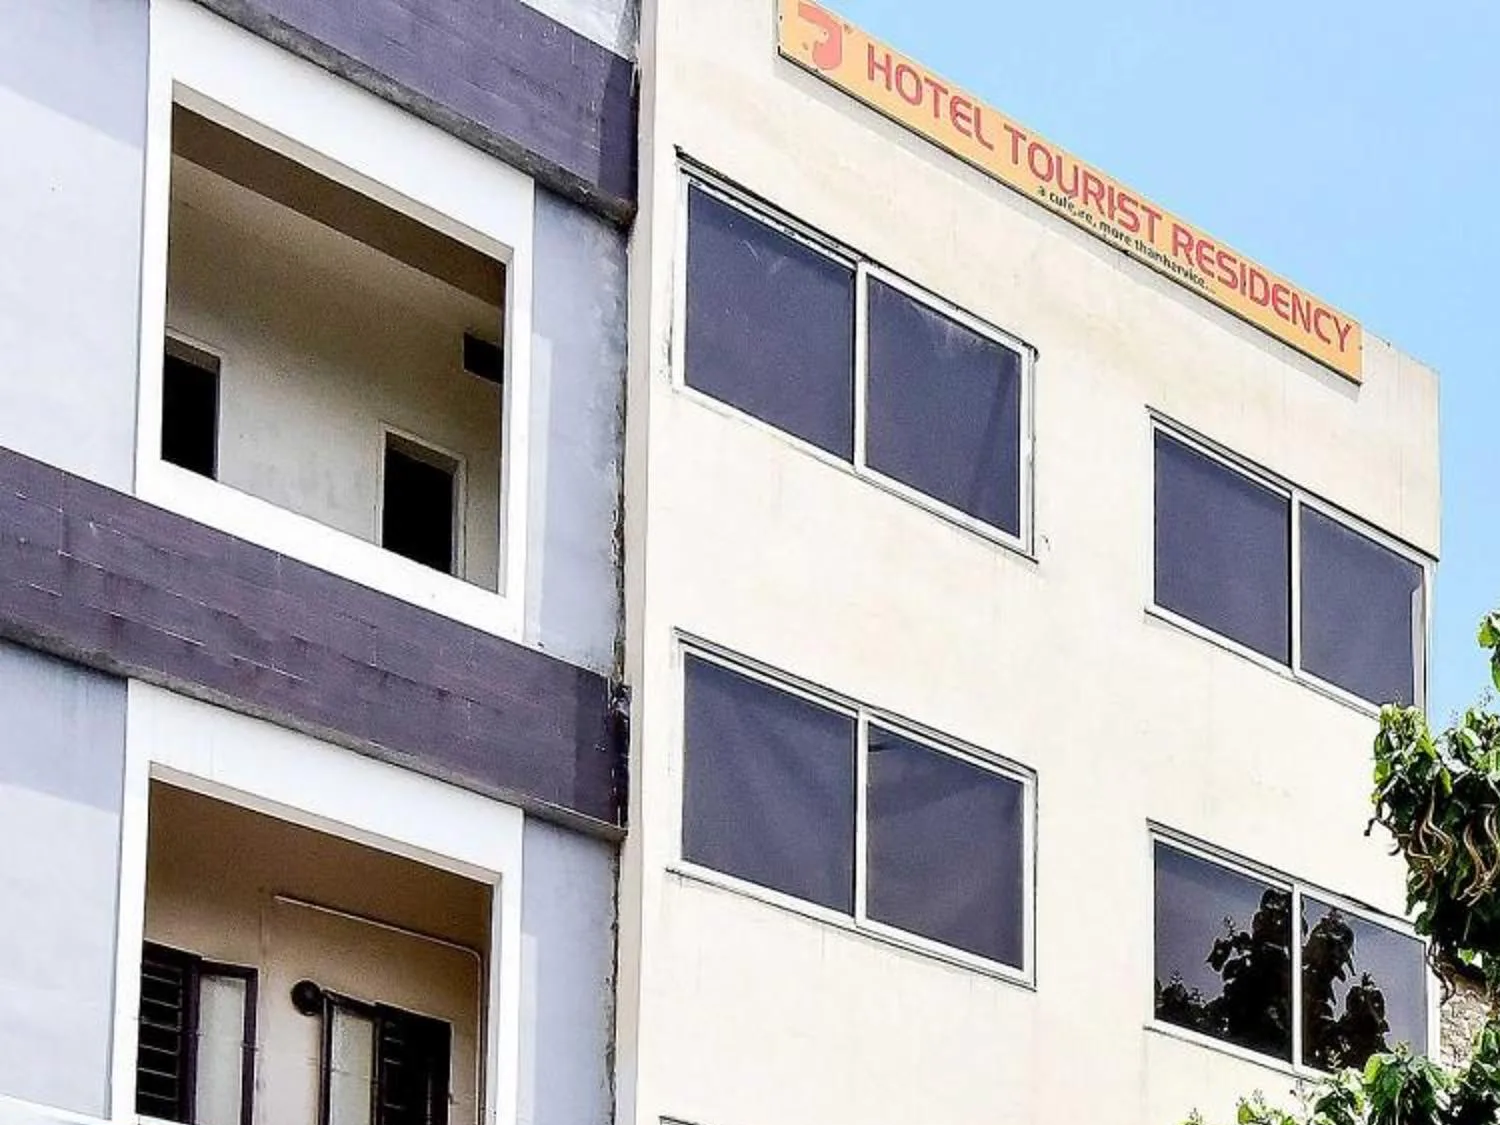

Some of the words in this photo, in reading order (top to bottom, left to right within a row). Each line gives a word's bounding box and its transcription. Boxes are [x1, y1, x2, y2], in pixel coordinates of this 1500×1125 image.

[867, 42, 994, 151] HOTEL
[1003, 122, 1163, 244] TOURIST
[1171, 223, 1354, 354] RESIDENCY
[1100, 220, 1133, 246] more
